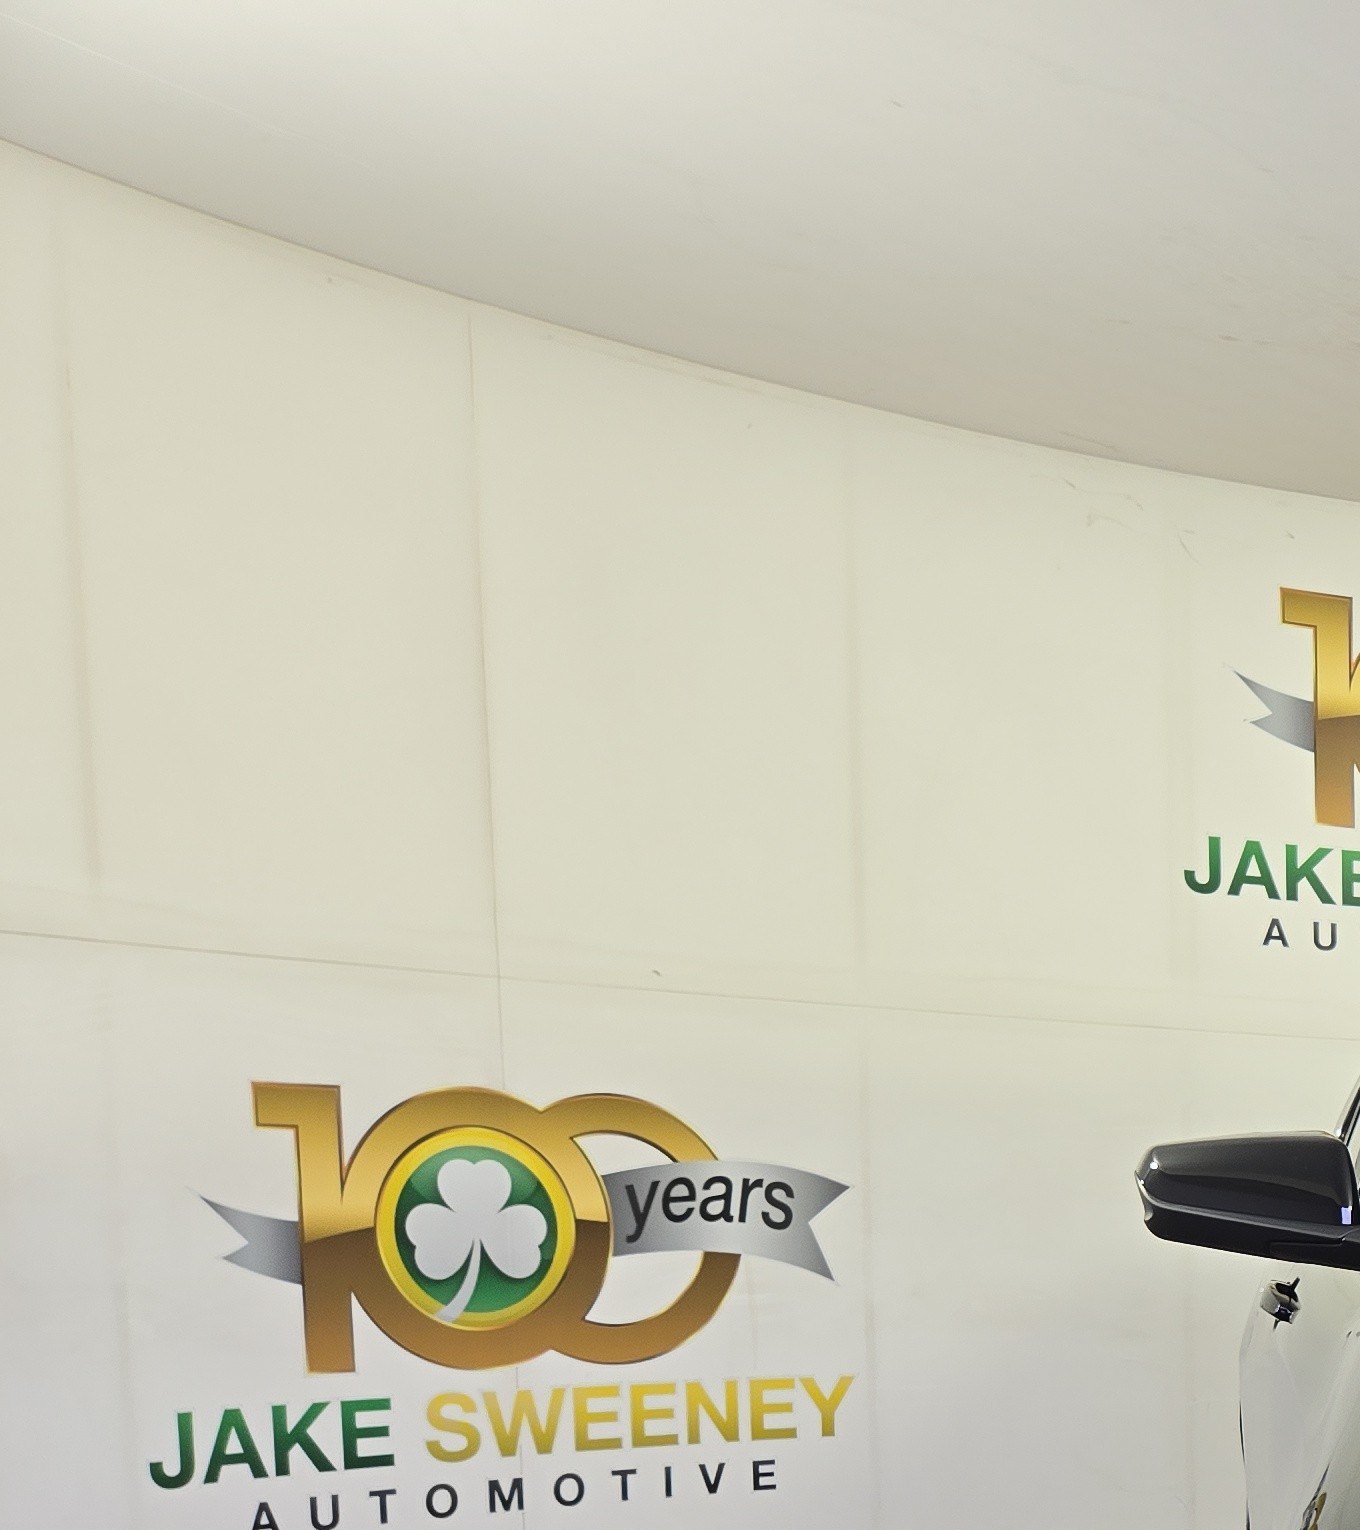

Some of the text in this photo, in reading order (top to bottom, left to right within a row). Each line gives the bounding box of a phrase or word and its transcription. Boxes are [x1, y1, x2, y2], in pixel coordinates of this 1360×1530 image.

[624, 1173, 795, 1242] years
[149, 1376, 855, 1490] JAKE SWEENEY
